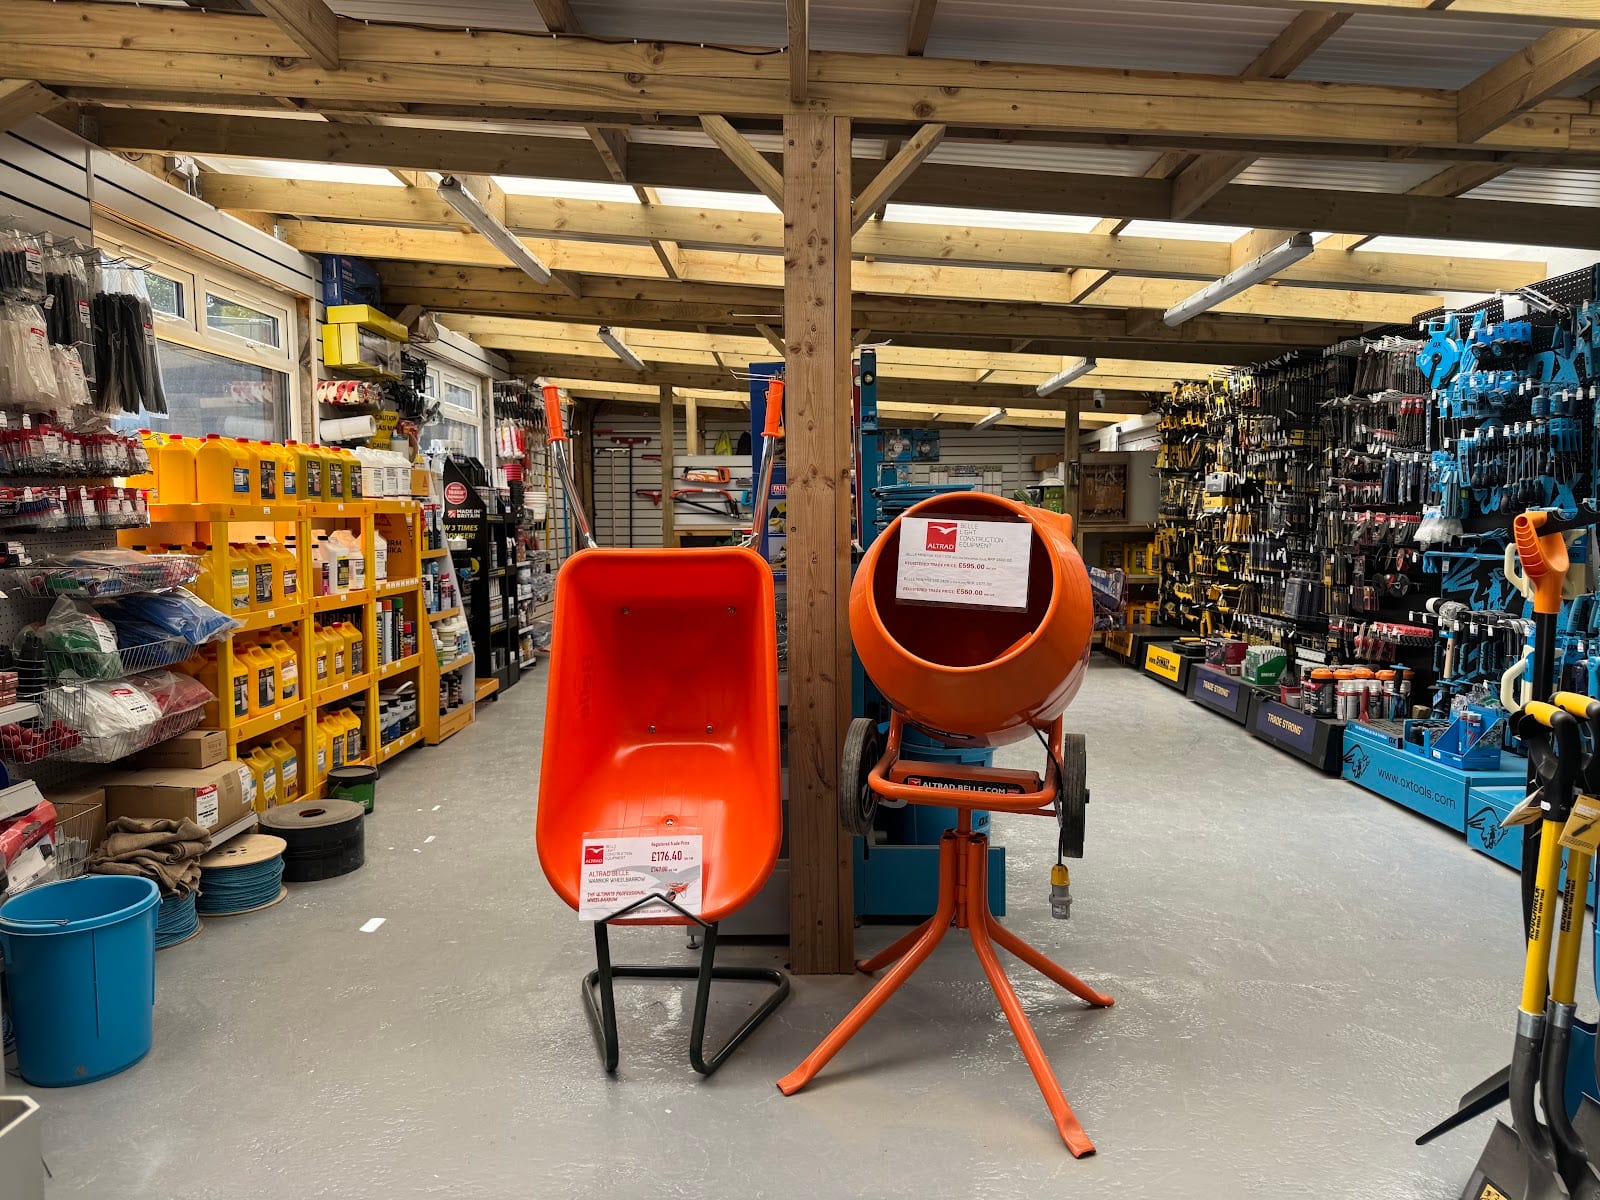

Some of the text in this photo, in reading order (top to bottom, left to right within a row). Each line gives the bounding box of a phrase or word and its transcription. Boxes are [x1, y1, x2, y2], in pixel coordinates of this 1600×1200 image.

[375, 414, 398, 422] CAUTION
[960, 522, 979, 530] BELLE
[959, 535, 1004, 544] CONSTRUCTION
[926, 542, 955, 551] ALTRAD
[958, 541, 993, 549] EQUIPMENT
[958, 562, 985, 570] £595.00
[1202, 680, 1214, 692] TRADE
[1267, 713, 1303, 735] TRADE STRONG
[922, 781, 1006, 795] ALTRAD-BELLE.COM
[1377, 766, 1456, 810] www.oxtools.com
[651, 850, 683, 862] £176.40
